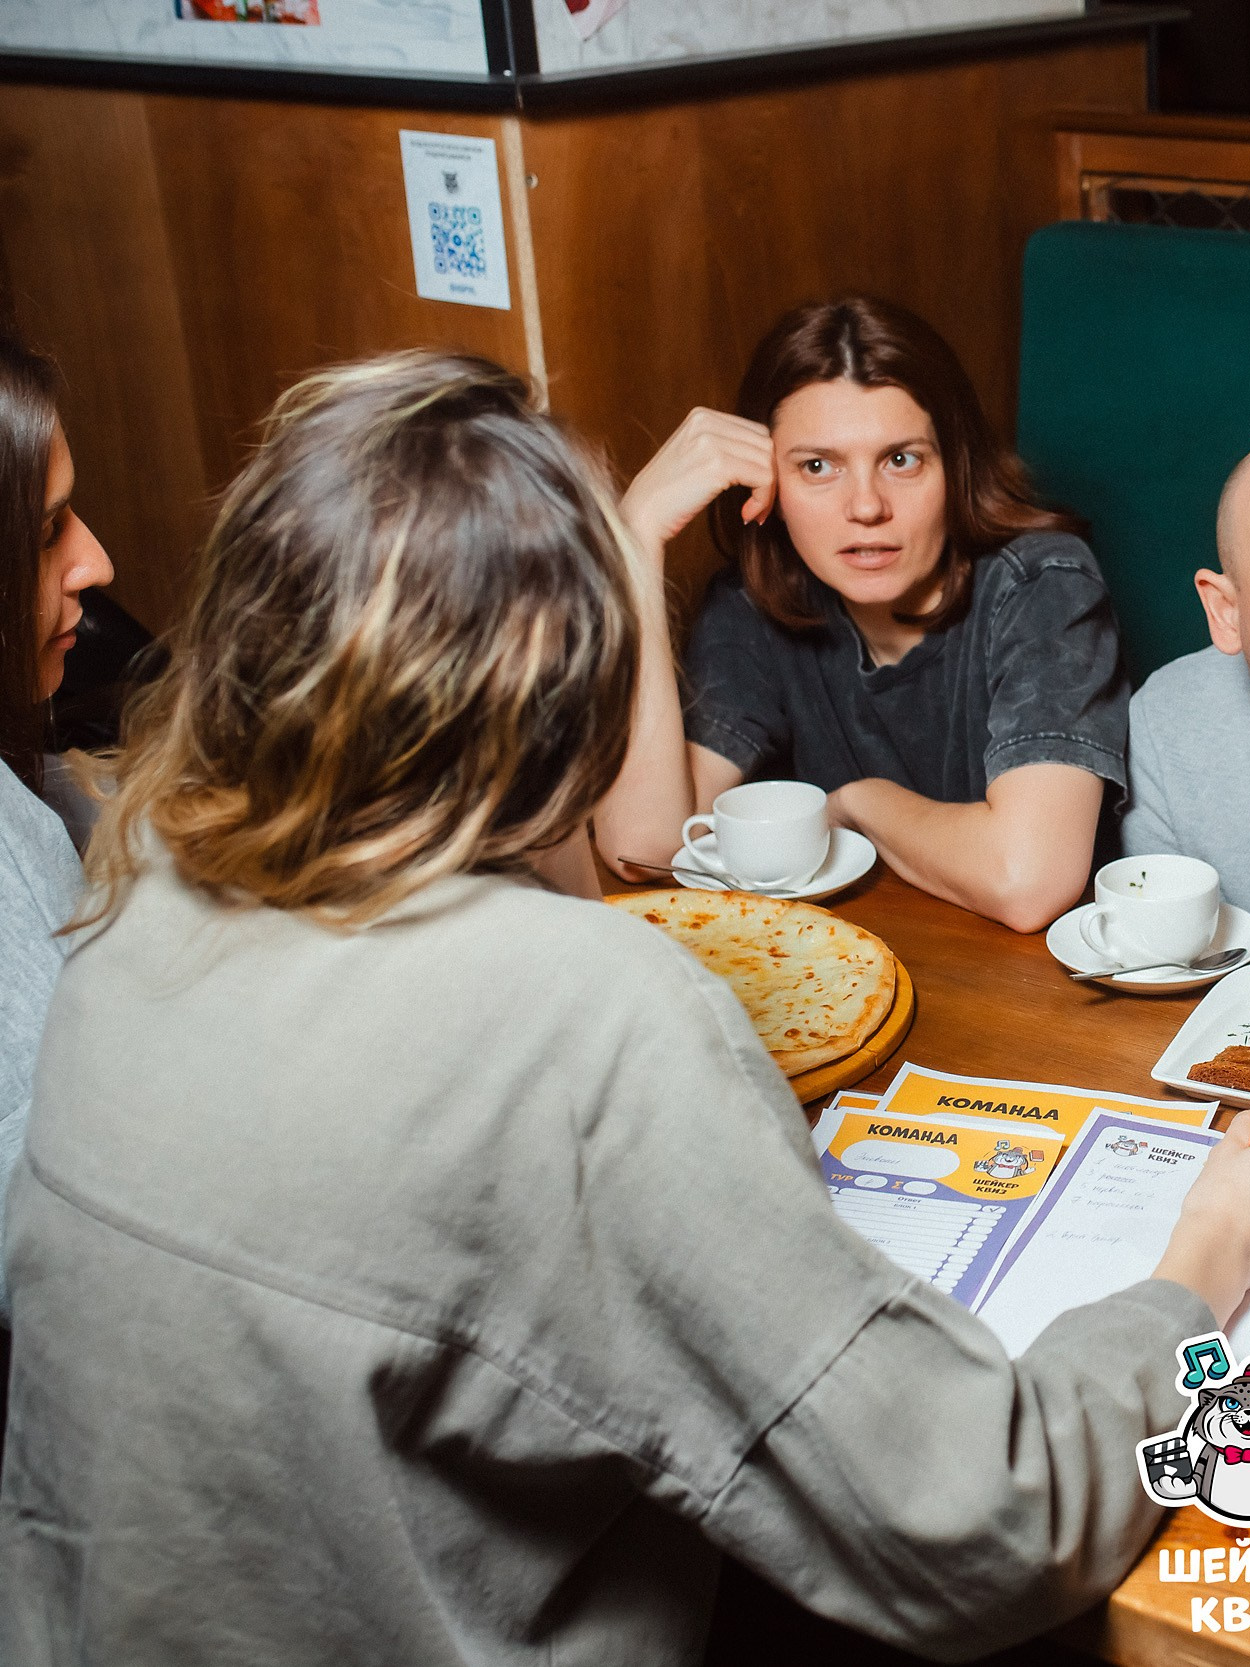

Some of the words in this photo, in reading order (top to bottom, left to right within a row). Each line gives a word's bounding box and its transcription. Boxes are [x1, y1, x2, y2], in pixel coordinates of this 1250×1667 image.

[936, 1095, 1059, 1121] КОМАНДА
[867, 1123, 958, 1145] КОМАНДА
[1148, 1153, 1178, 1165] КВИЗ
[1151, 1146, 1196, 1161] ШЕЙКЕР
[830, 1173, 854, 1181] ТУР
[972, 1178, 1020, 1189] ШЕЙКЕР
[976, 1186, 1007, 1195] КВИЗ
